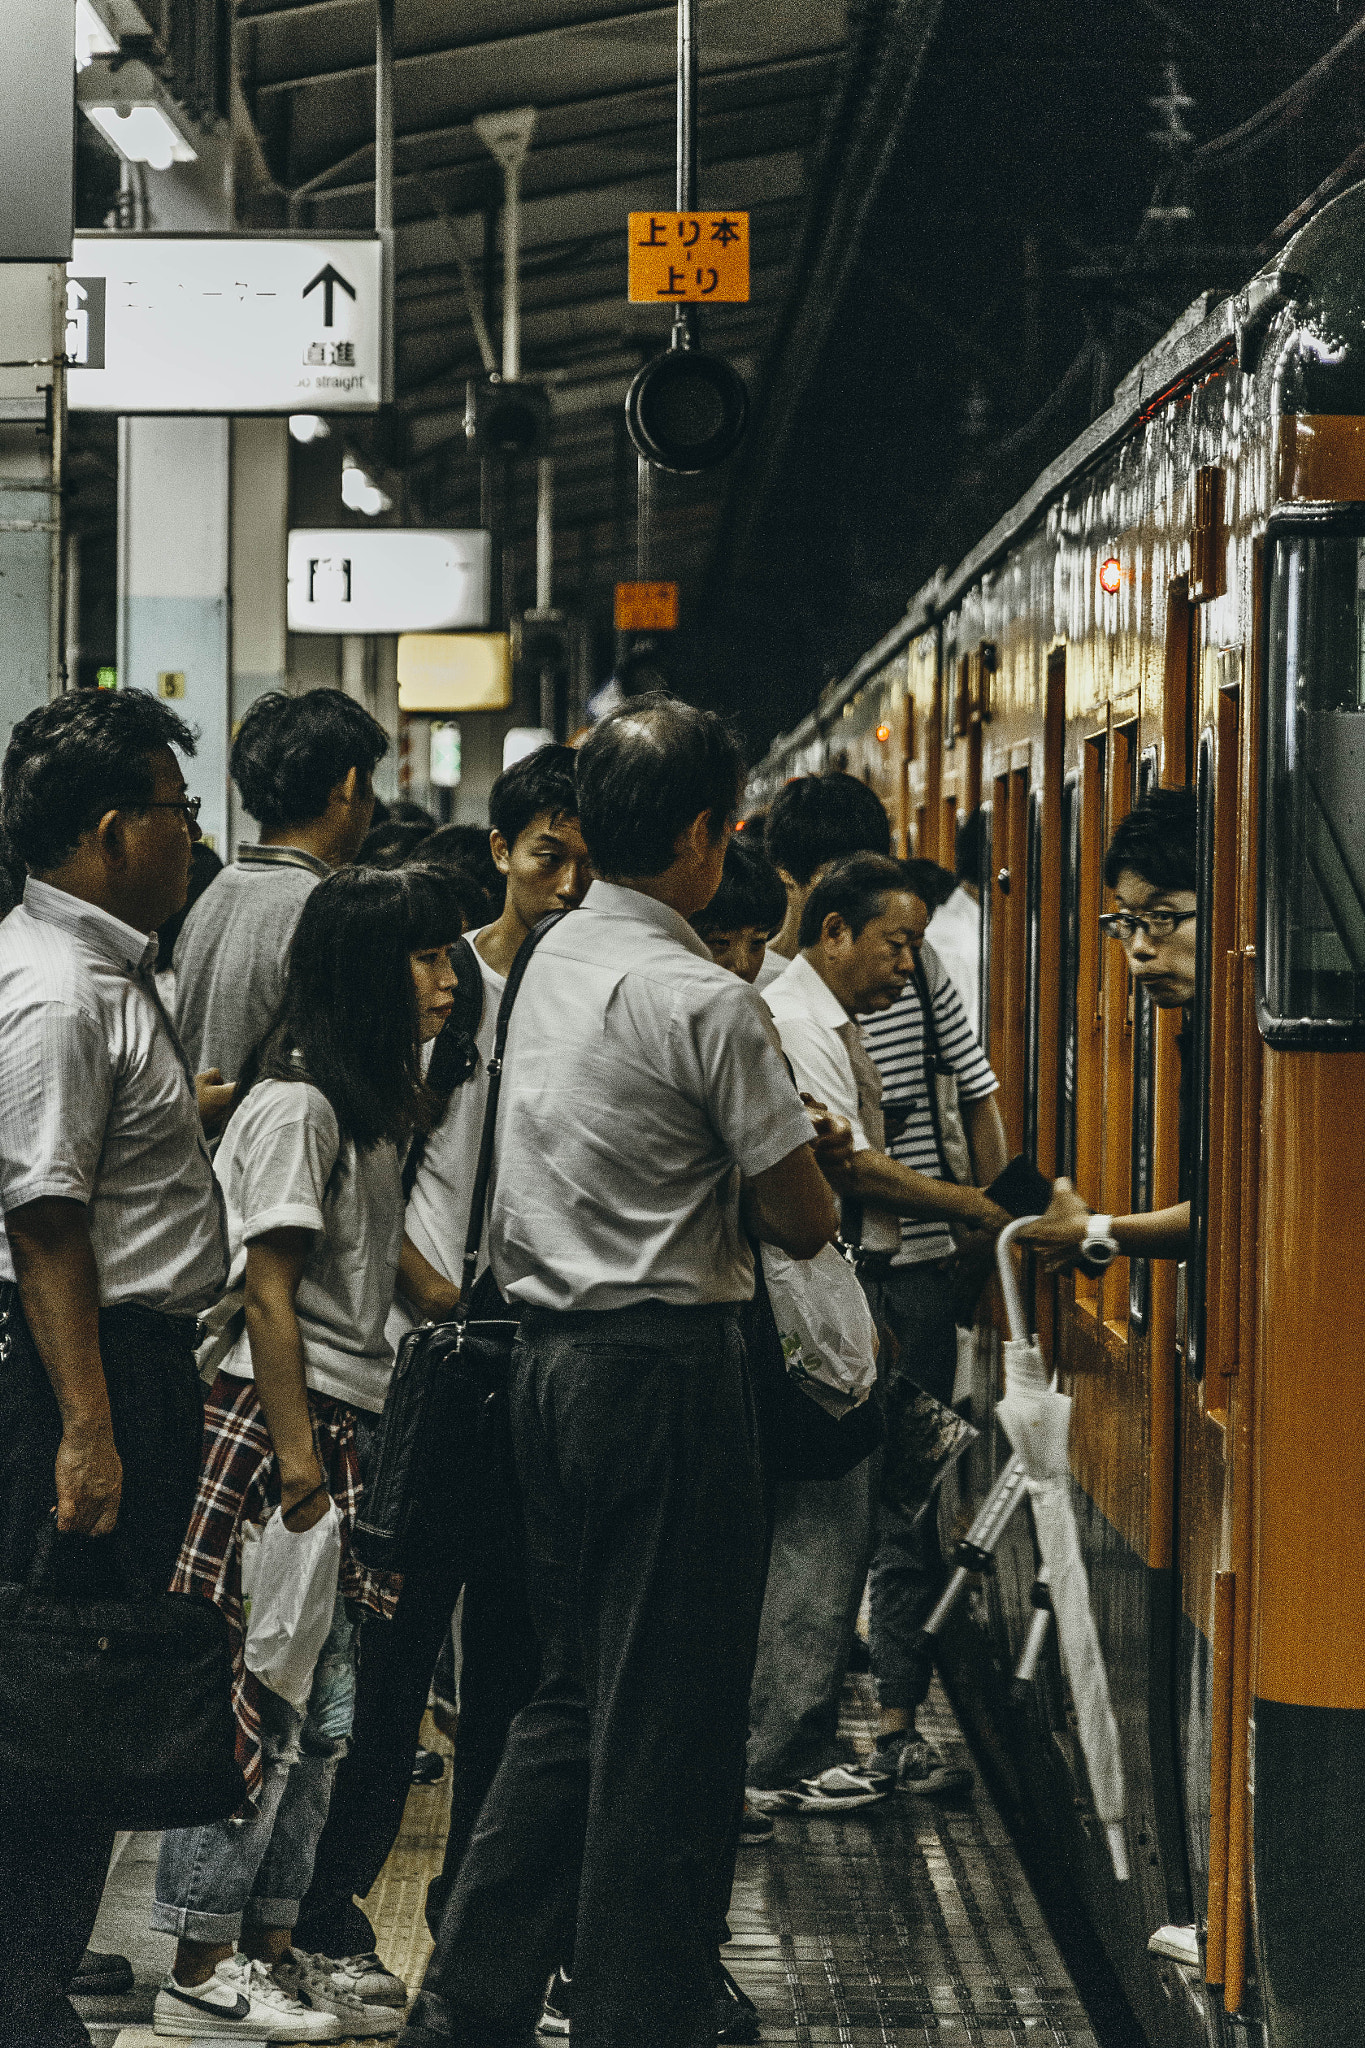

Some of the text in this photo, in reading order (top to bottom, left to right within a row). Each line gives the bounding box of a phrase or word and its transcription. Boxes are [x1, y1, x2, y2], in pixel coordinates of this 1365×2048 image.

[639, 218, 739, 247] 上り本
[657, 266, 718, 294] 上り
[316, 376, 364, 391] straight
